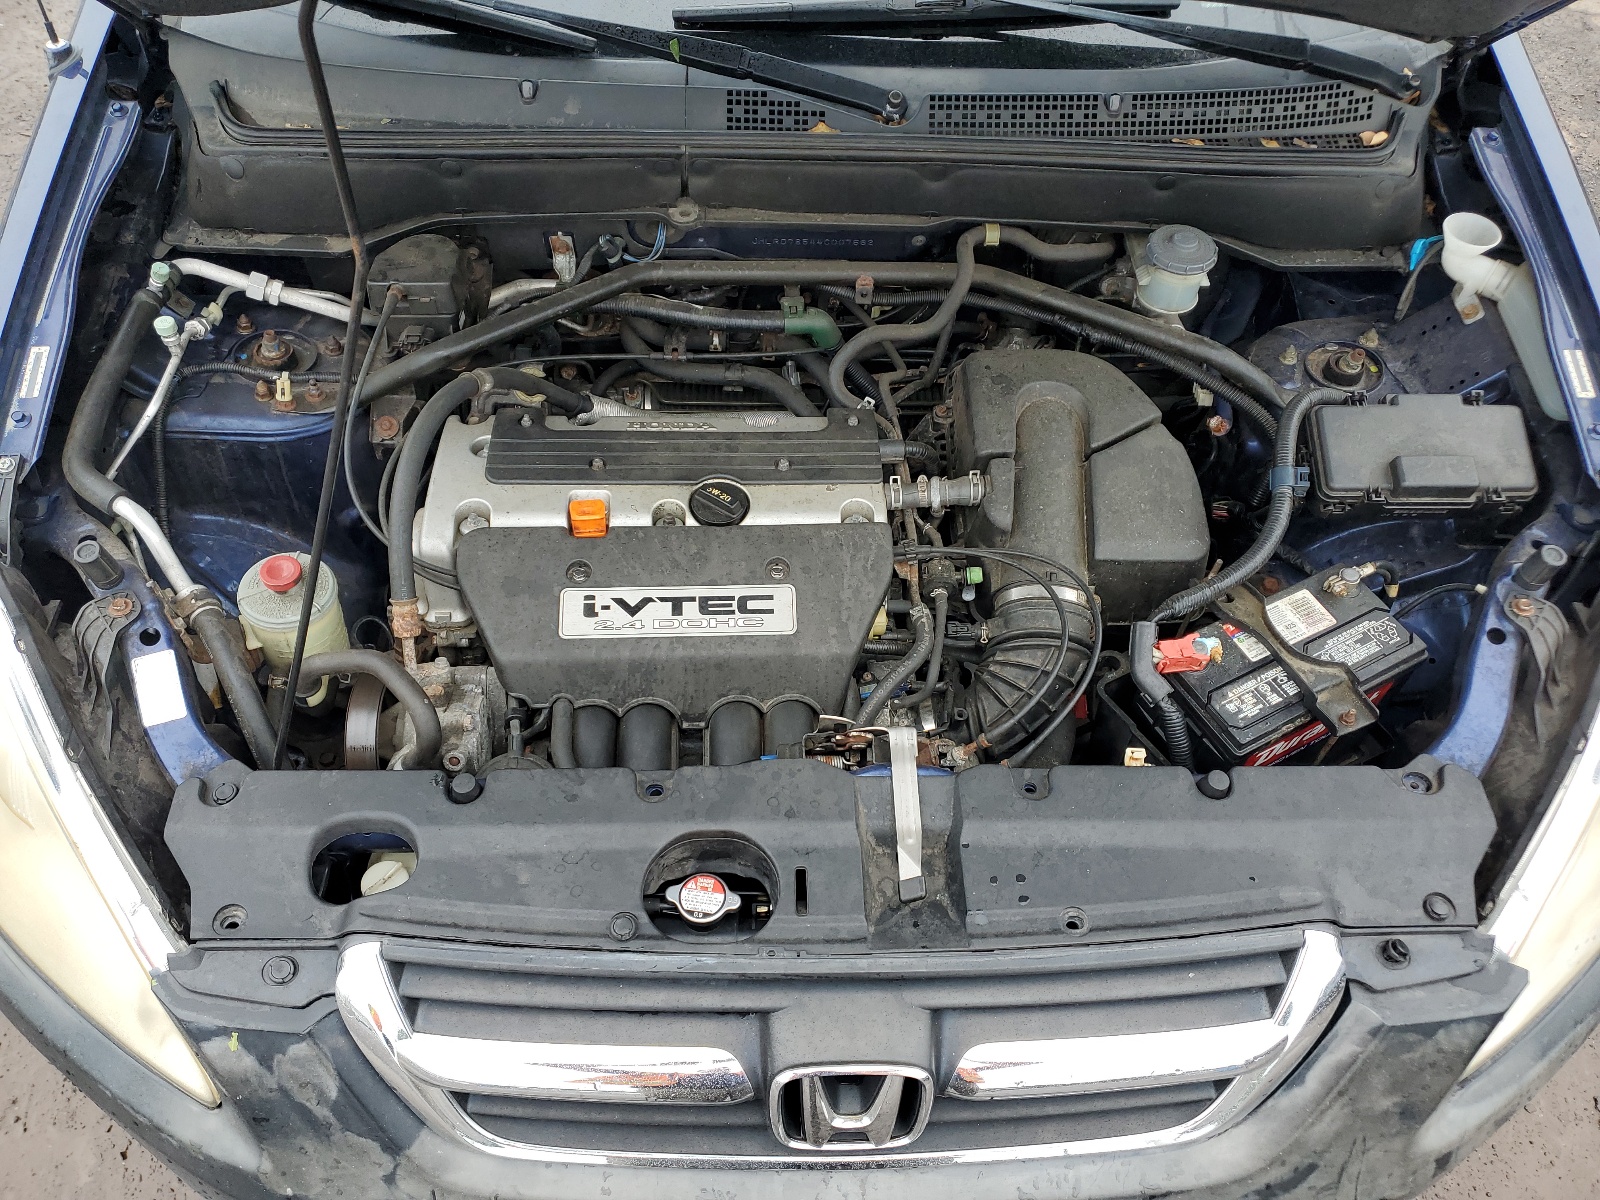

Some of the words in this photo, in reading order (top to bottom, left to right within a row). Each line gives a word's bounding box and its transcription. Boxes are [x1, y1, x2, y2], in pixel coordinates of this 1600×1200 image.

[626, 421, 717, 431] HONDA
[706, 486, 731, 502] 5W-20
[583, 594, 775, 618] i-VTEC
[594, 619, 645, 631] 2.4
[652, 617, 765, 630] DOHC
[1233, 679, 1258, 696] DANGER
